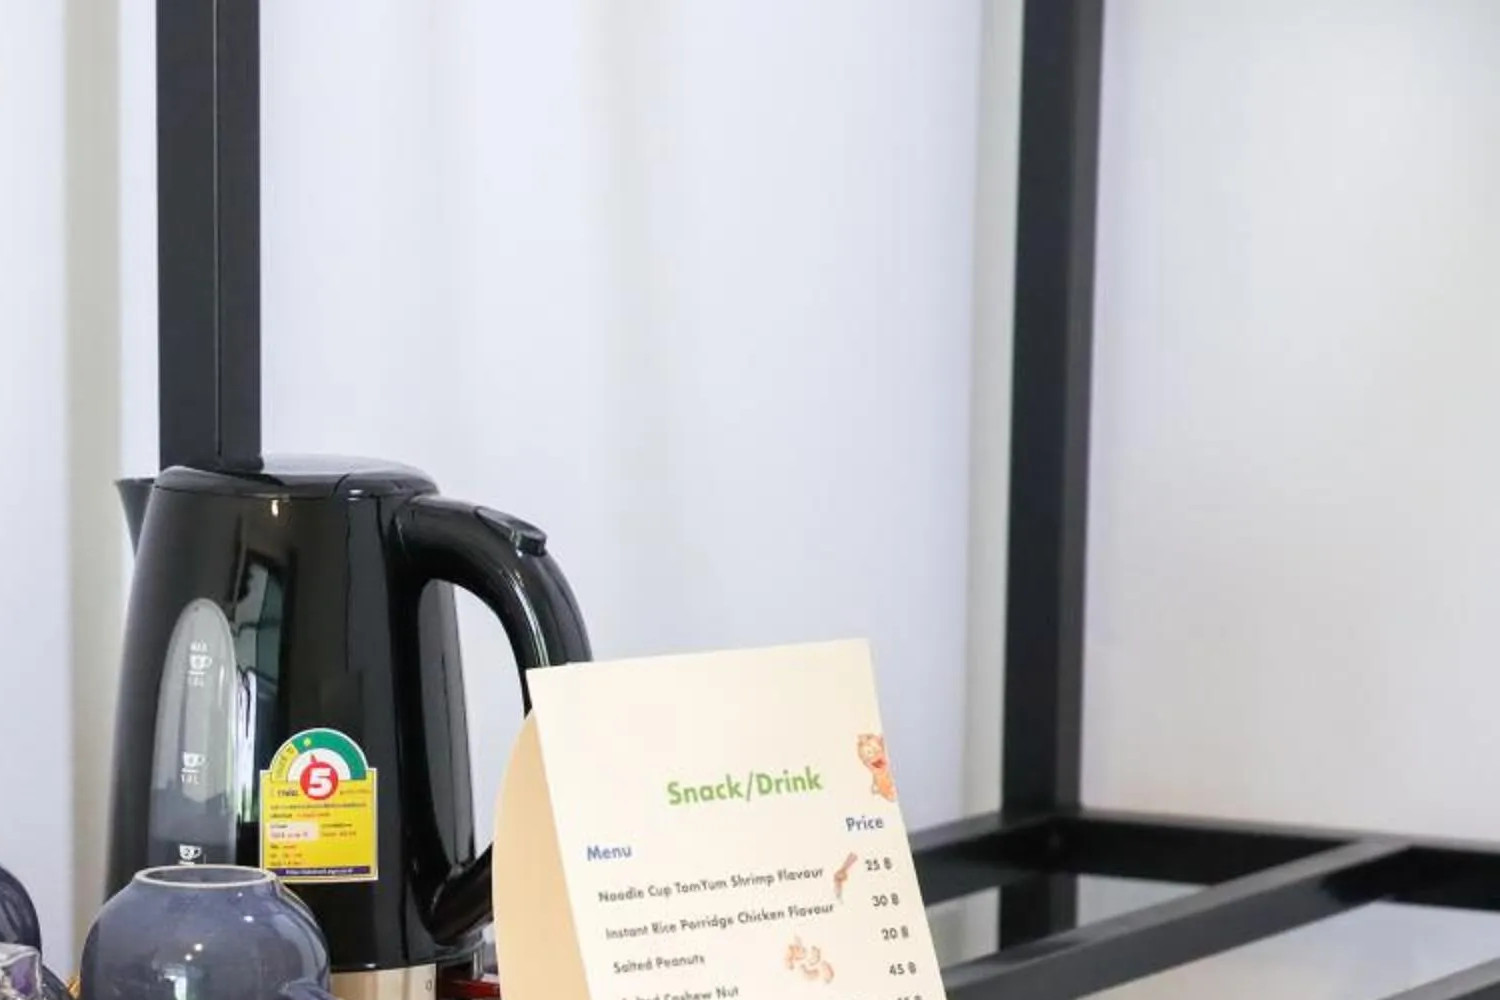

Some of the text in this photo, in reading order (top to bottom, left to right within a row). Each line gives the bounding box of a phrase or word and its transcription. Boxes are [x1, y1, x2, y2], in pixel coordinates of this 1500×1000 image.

[307, 767, 334, 798] 5
[667, 766, 822, 805] Snack/Drink
[846, 815, 884, 832] Price
[586, 845, 633, 862] Menu
[598, 886, 645, 902] Noodle
[648, 885, 672, 899] Cup
[731, 873, 775, 889] Shrimp
[777, 868, 824, 882] Flavour
[605, 925, 648, 940] Instant
[651, 921, 677, 935] Rice
[738, 907, 785, 924] Chicken
[788, 903, 834, 918] Flavour
[872, 895, 888, 907] 30
[613, 959, 653, 974] Salted
[655, 954, 705, 968] Peanuts
[716, 986, 739, 999] Nut
